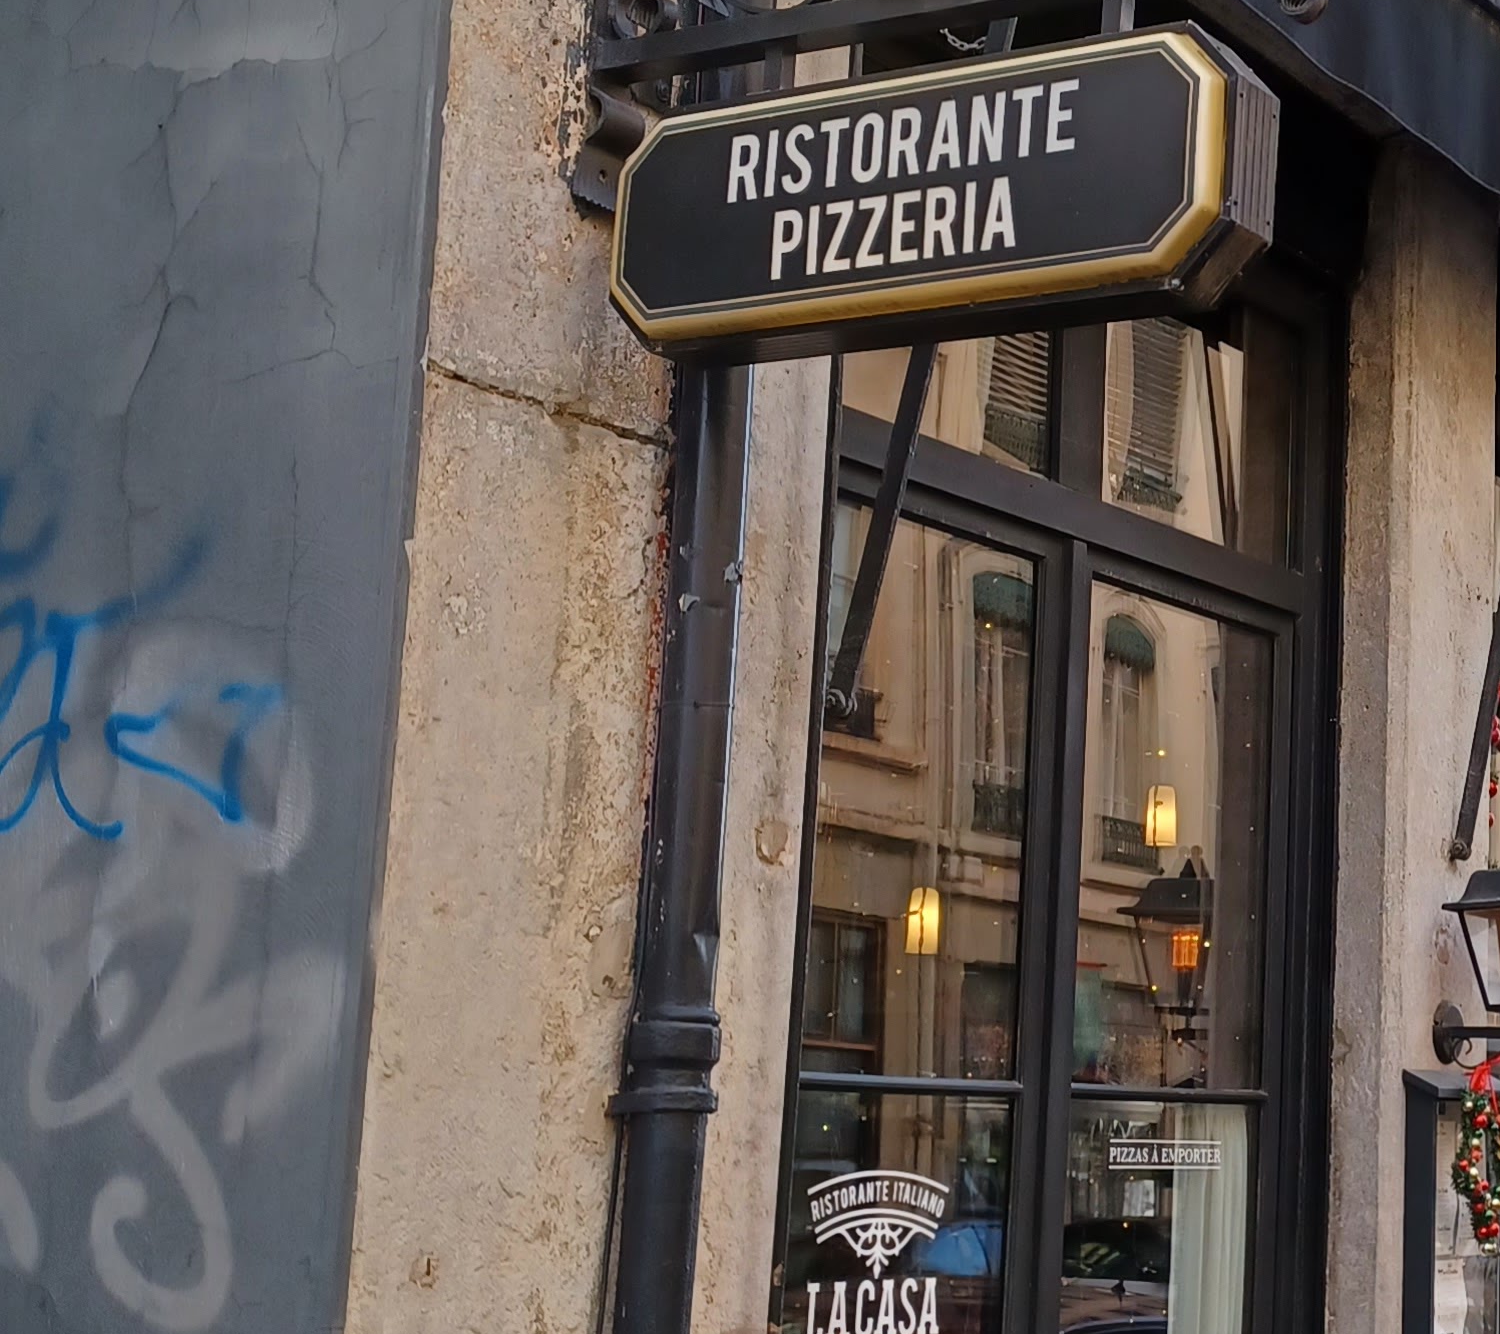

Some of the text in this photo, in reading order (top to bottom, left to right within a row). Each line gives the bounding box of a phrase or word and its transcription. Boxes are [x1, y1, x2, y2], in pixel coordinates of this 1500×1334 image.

[726, 77, 1081, 204] RISTORANTE
[769, 175, 1017, 282] PIZZERIA
[1108, 1143, 1221, 1163] PIZZAS À EMPORTER
[810, 1180, 946, 1223] RISTORANTE ITALIANO
